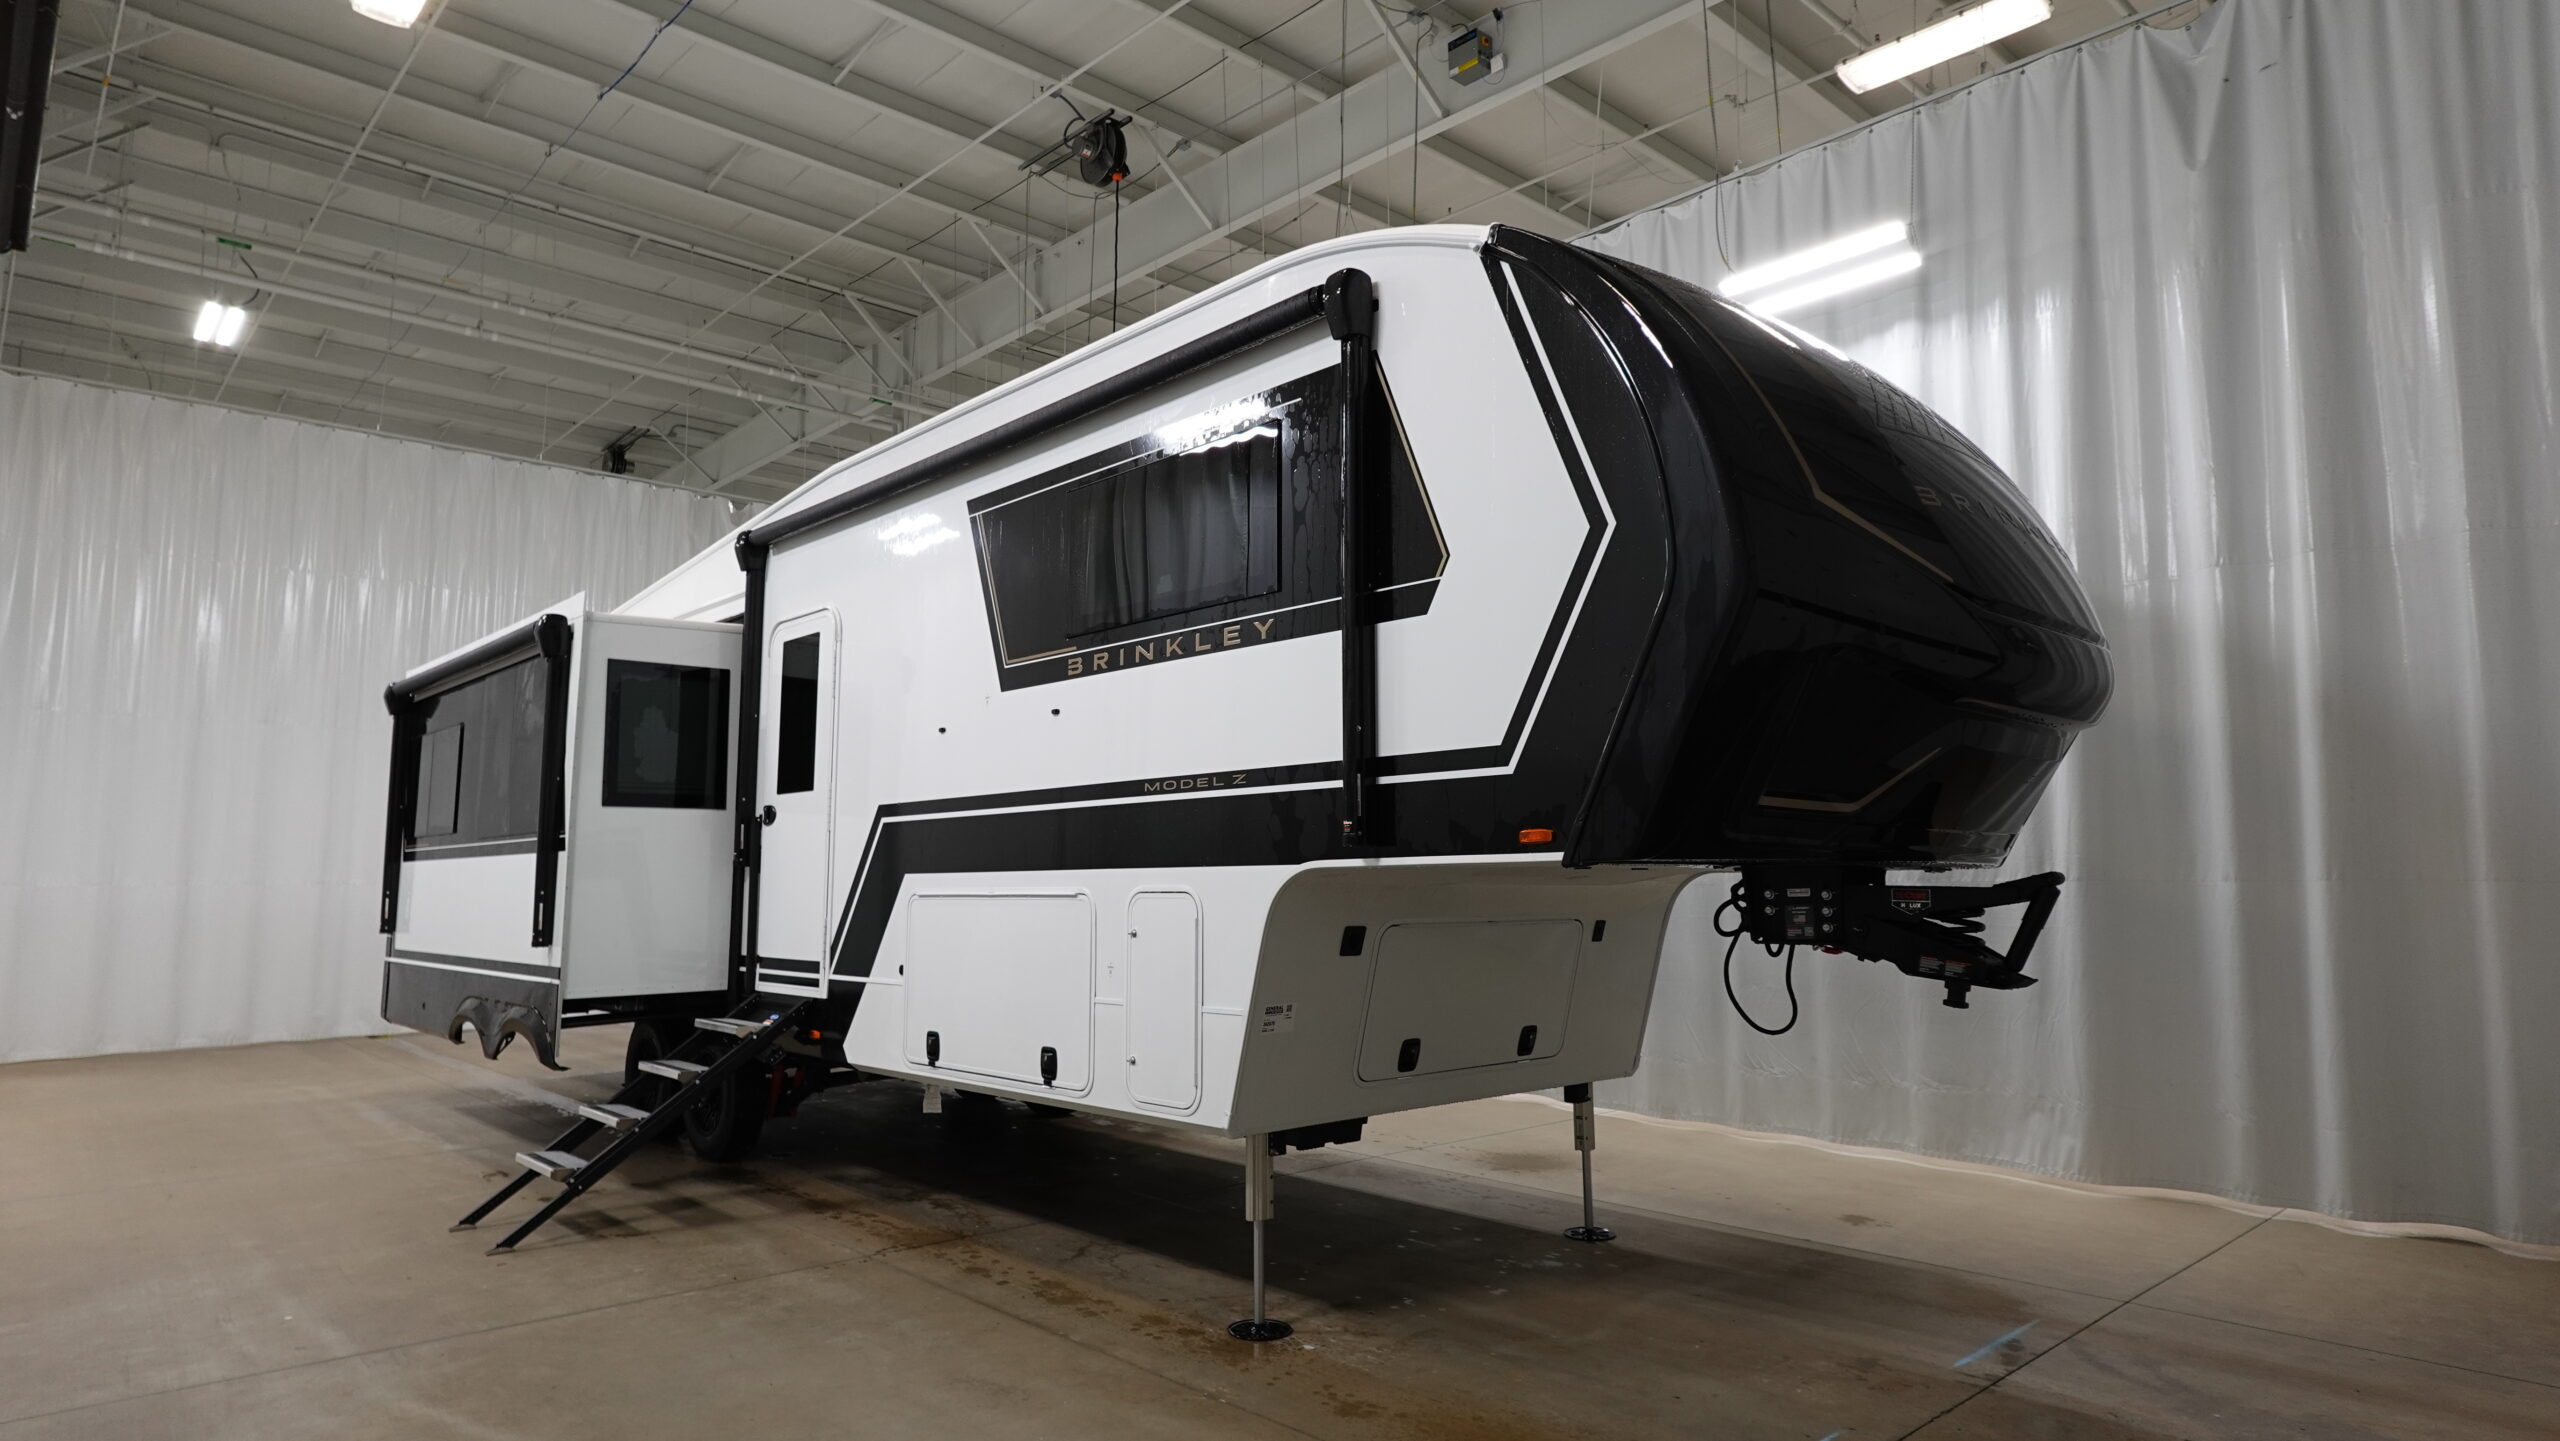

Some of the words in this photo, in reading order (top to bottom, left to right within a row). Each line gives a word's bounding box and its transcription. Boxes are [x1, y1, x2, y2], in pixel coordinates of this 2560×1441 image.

[1067, 618, 1275, 676] BRINKLEY
[1144, 776, 1225, 792] MODEL
[1232, 773, 1247, 785] Z
